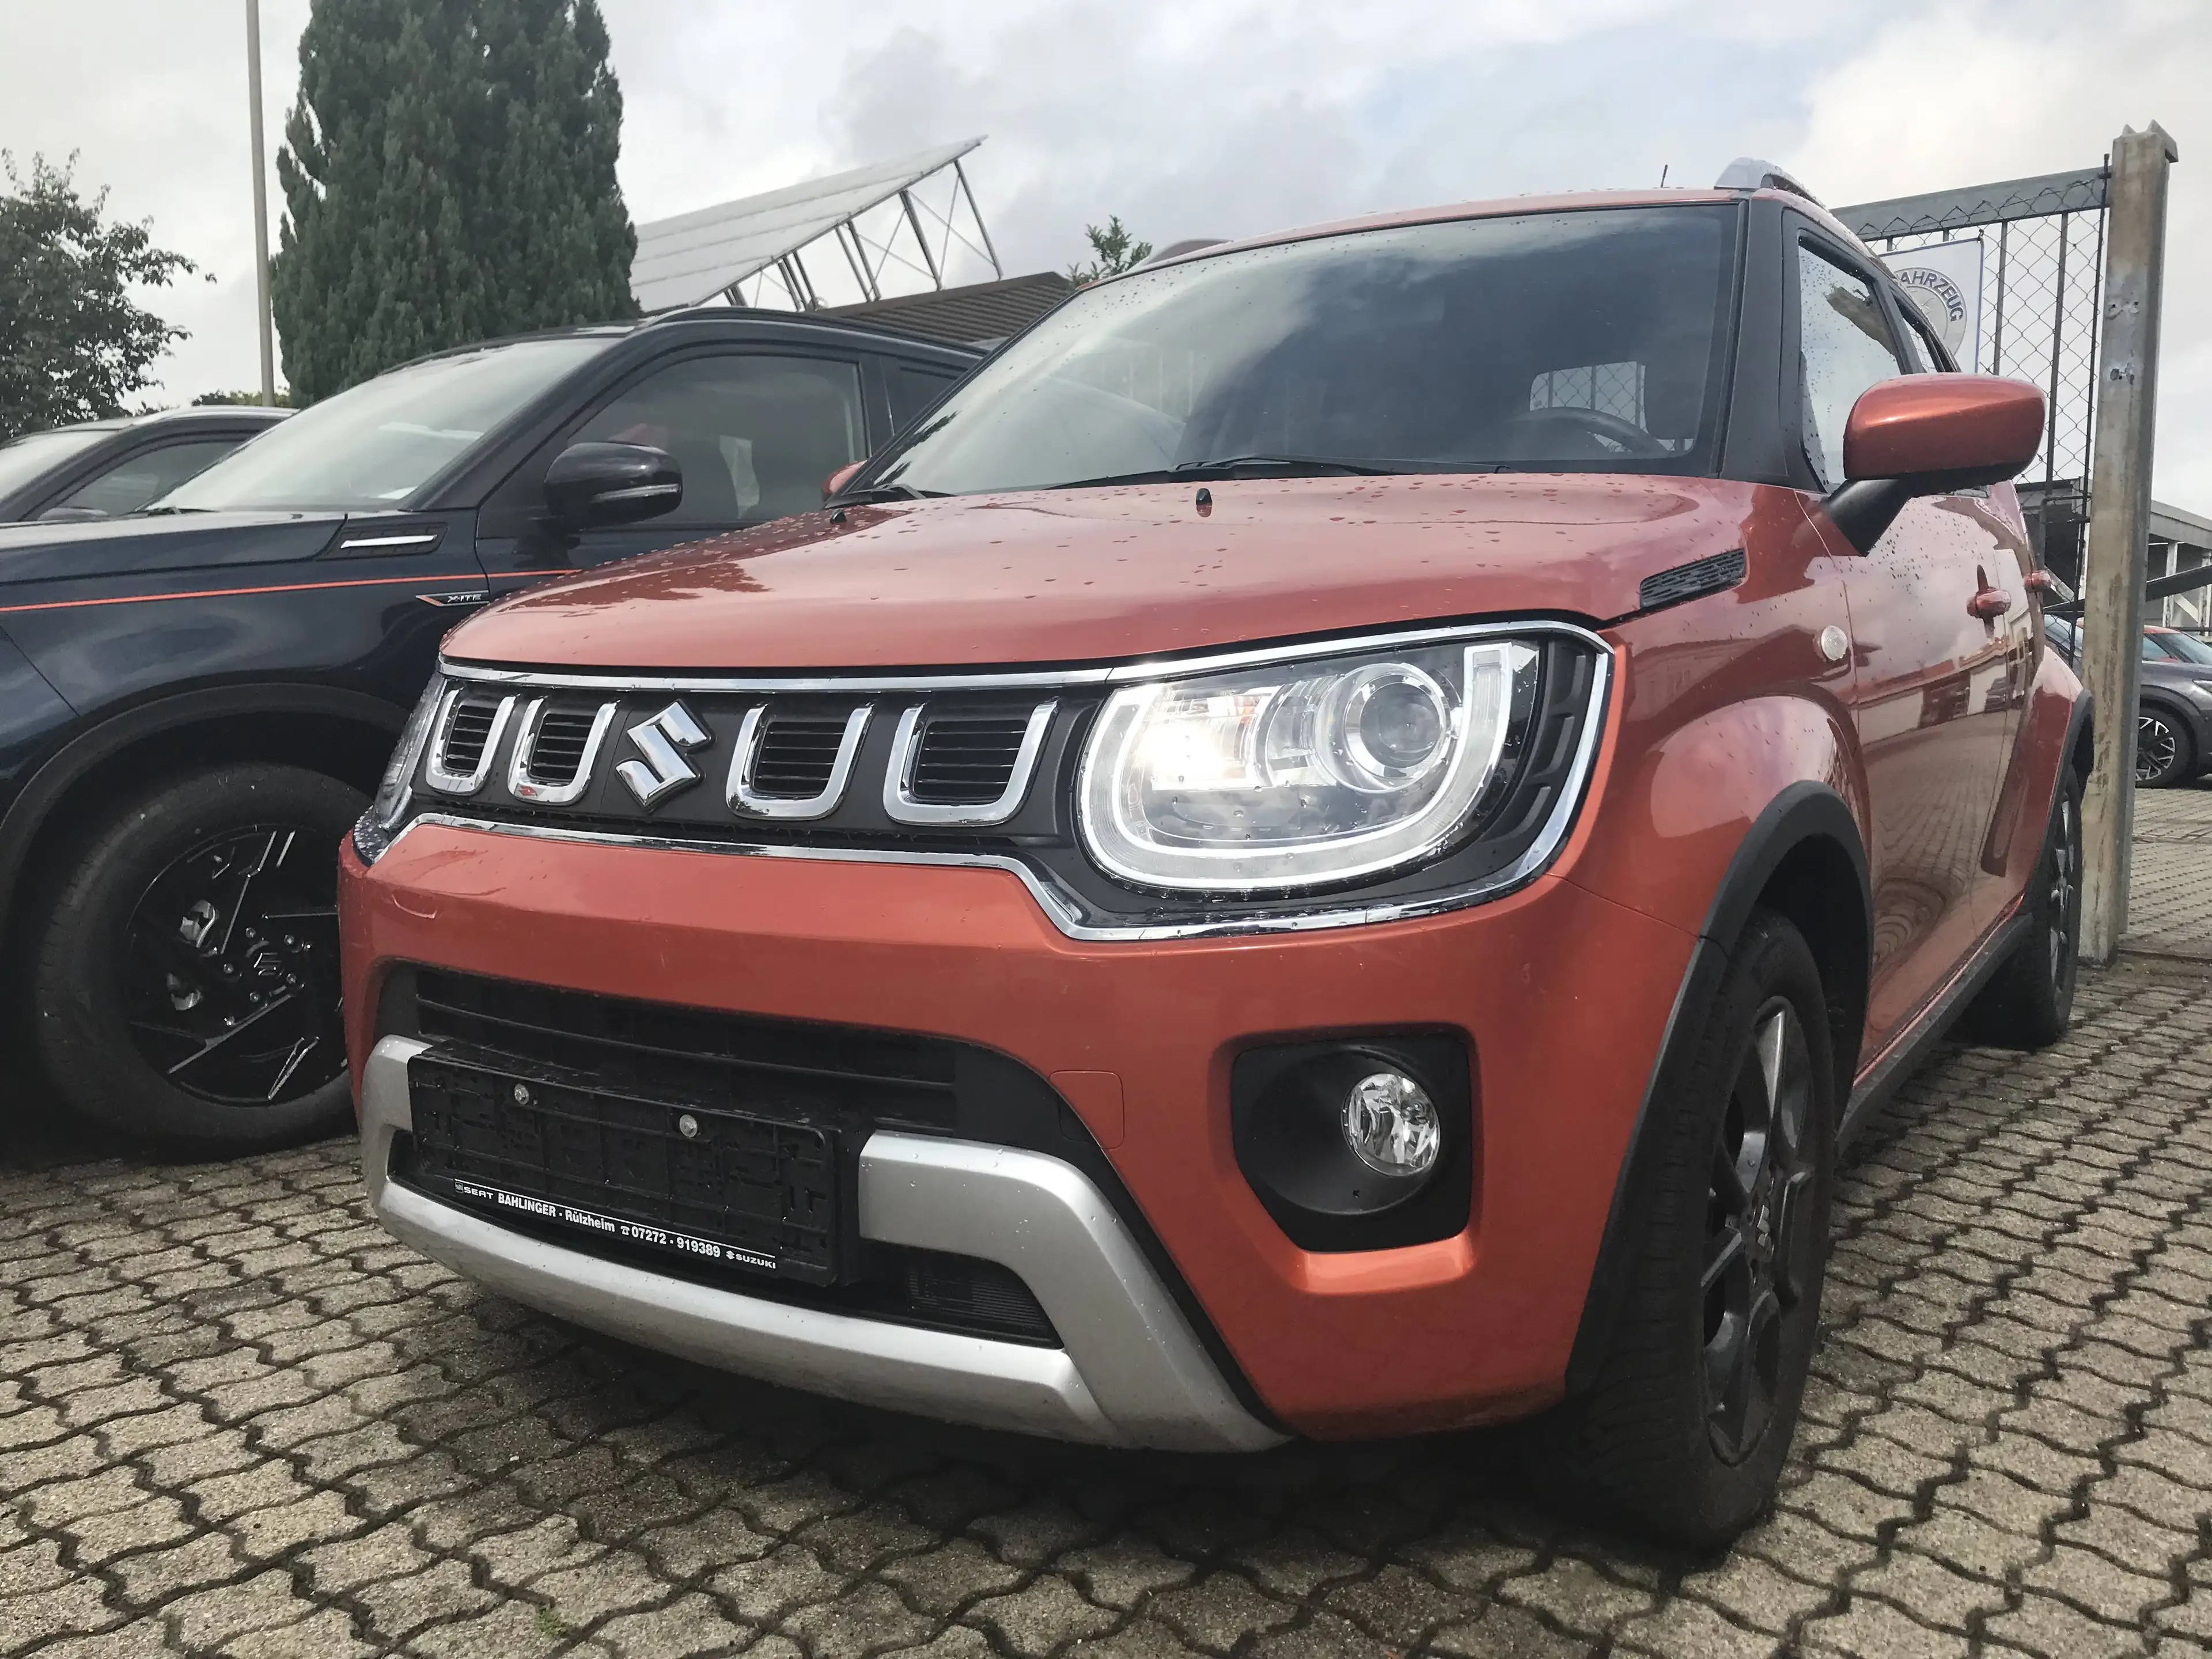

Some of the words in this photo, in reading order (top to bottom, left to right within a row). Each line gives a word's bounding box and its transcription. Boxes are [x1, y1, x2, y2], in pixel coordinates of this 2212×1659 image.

[1896, 271, 1964, 322] AHRZEUG
[464, 1186, 494, 1199] SEAT
[498, 1192, 556, 1217] BAHLINGER
[565, 1209, 616, 1232] Rülzheim
[631, 1226, 666, 1245] 07272
[676, 1237, 720, 1257] 919389
[736, 1253, 777, 1269] SUZUKI
